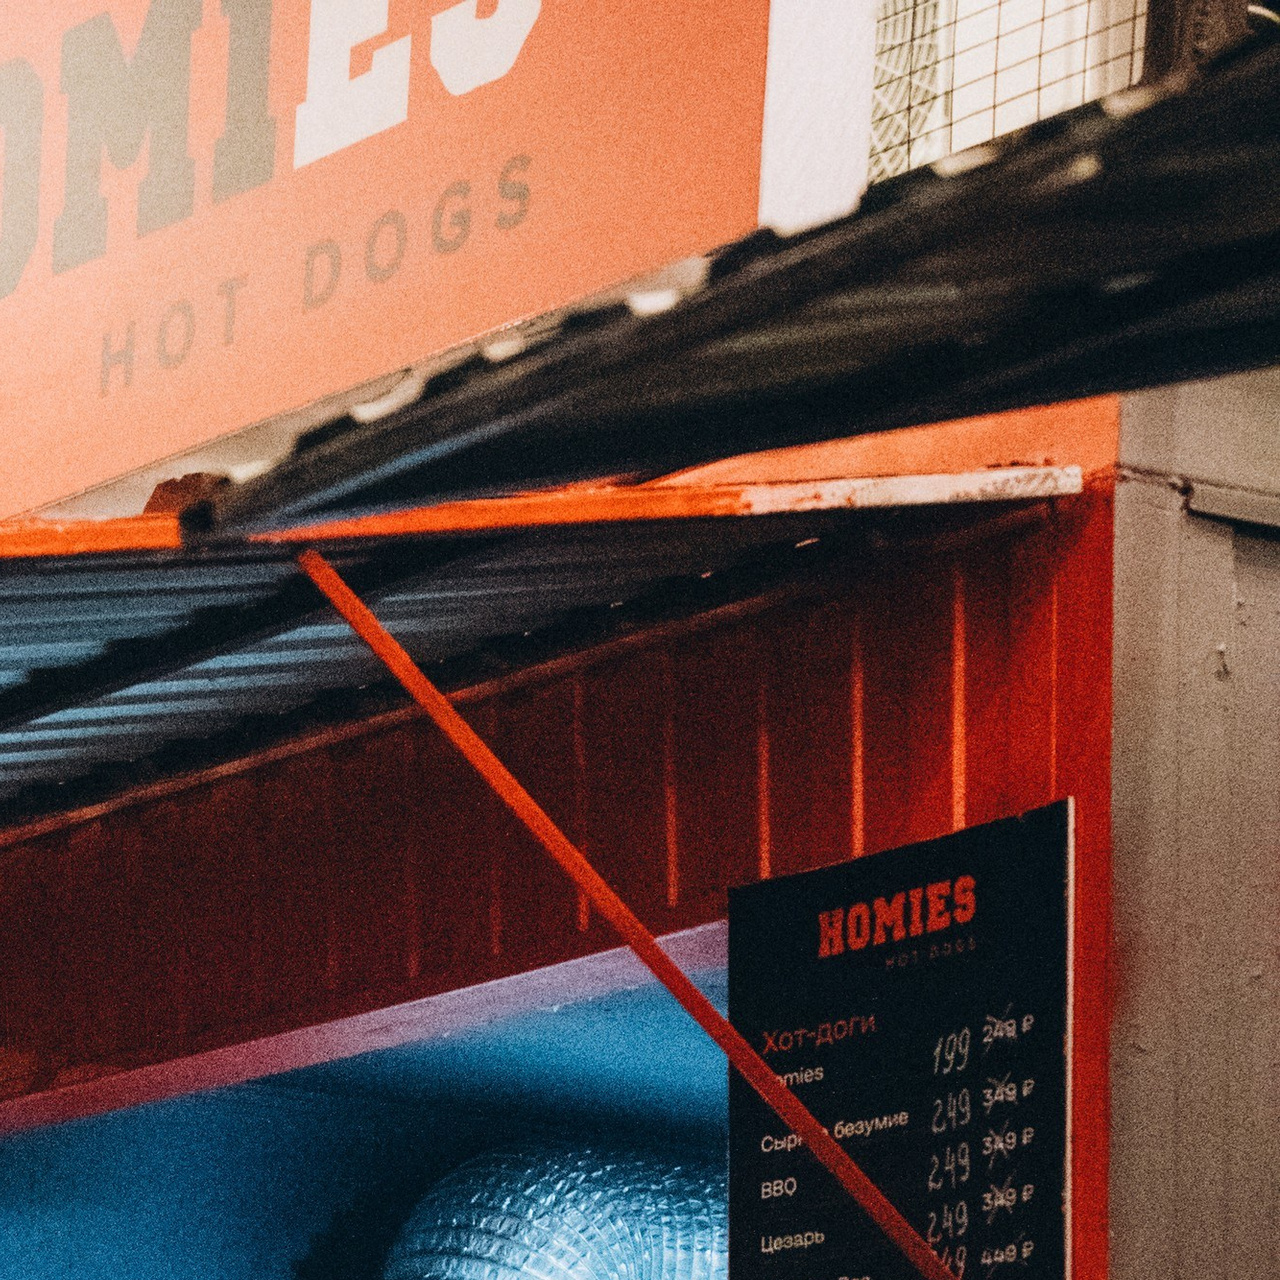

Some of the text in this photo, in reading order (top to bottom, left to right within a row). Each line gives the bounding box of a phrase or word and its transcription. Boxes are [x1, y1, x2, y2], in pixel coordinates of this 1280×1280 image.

[98, 153, 533, 398] HOT DOGS
[818, 875, 977, 959] HOMIES
[933, 1026, 971, 1075] 199
[833, 1110, 910, 1140] безумие
[931, 1087, 971, 1134] 249
[928, 1142, 970, 1193] 249
[760, 1230, 826, 1255] Цезарь
[926, 1200, 969, 1246] 249
